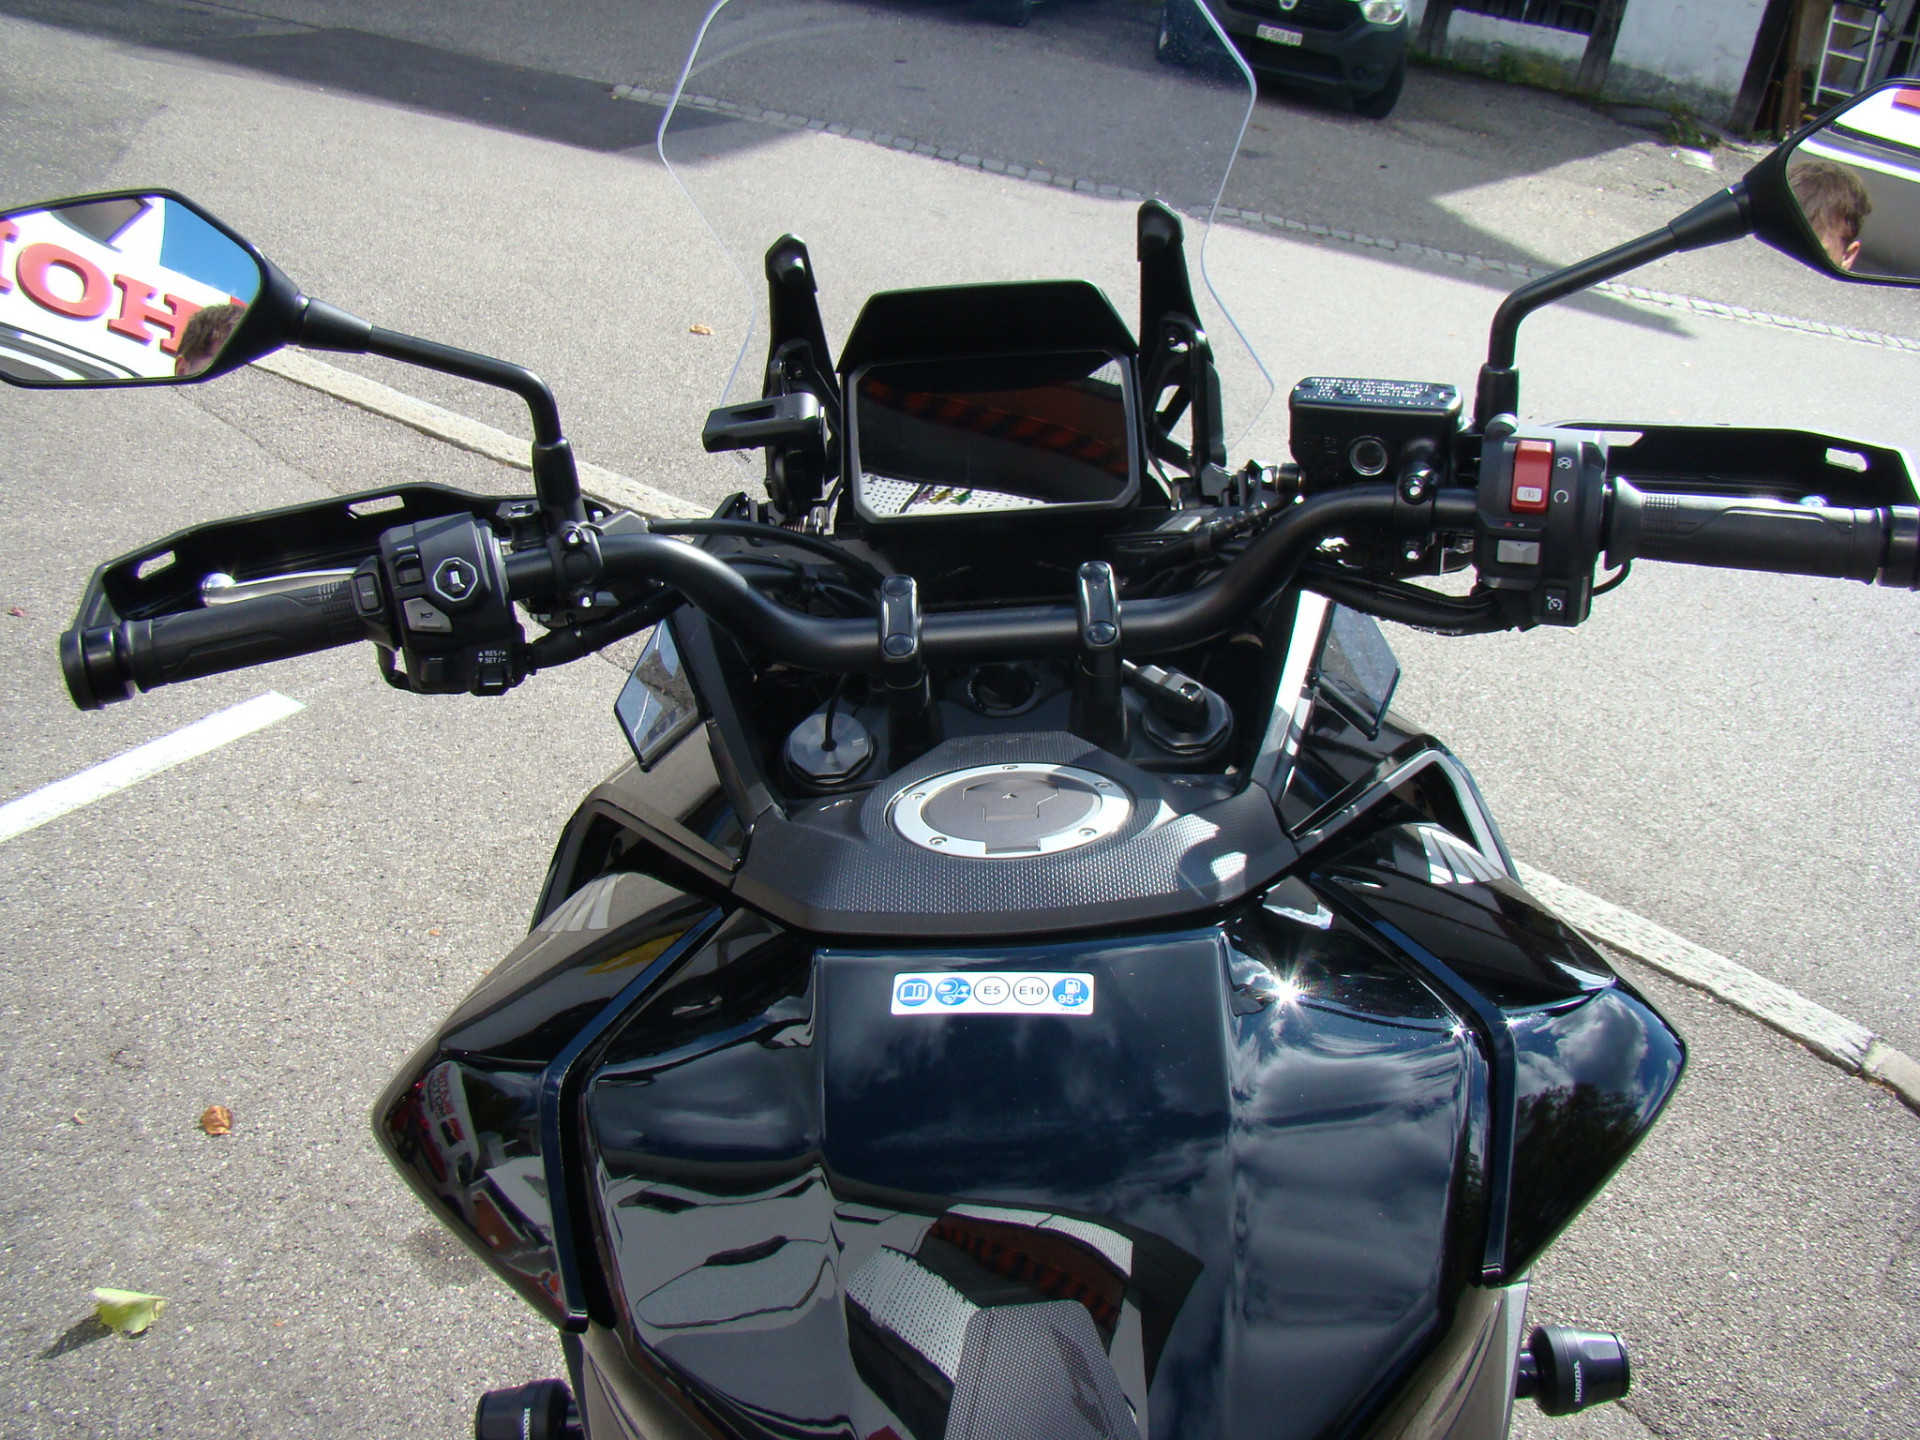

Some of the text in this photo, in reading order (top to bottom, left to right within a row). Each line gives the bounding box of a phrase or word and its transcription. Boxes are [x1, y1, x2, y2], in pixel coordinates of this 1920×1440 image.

[983, 985, 1001, 995] E5
[1019, 985, 1044, 995] E10
[1057, 993, 1085, 1004] 95+
[1573, 1359, 1582, 1403] HONDA
